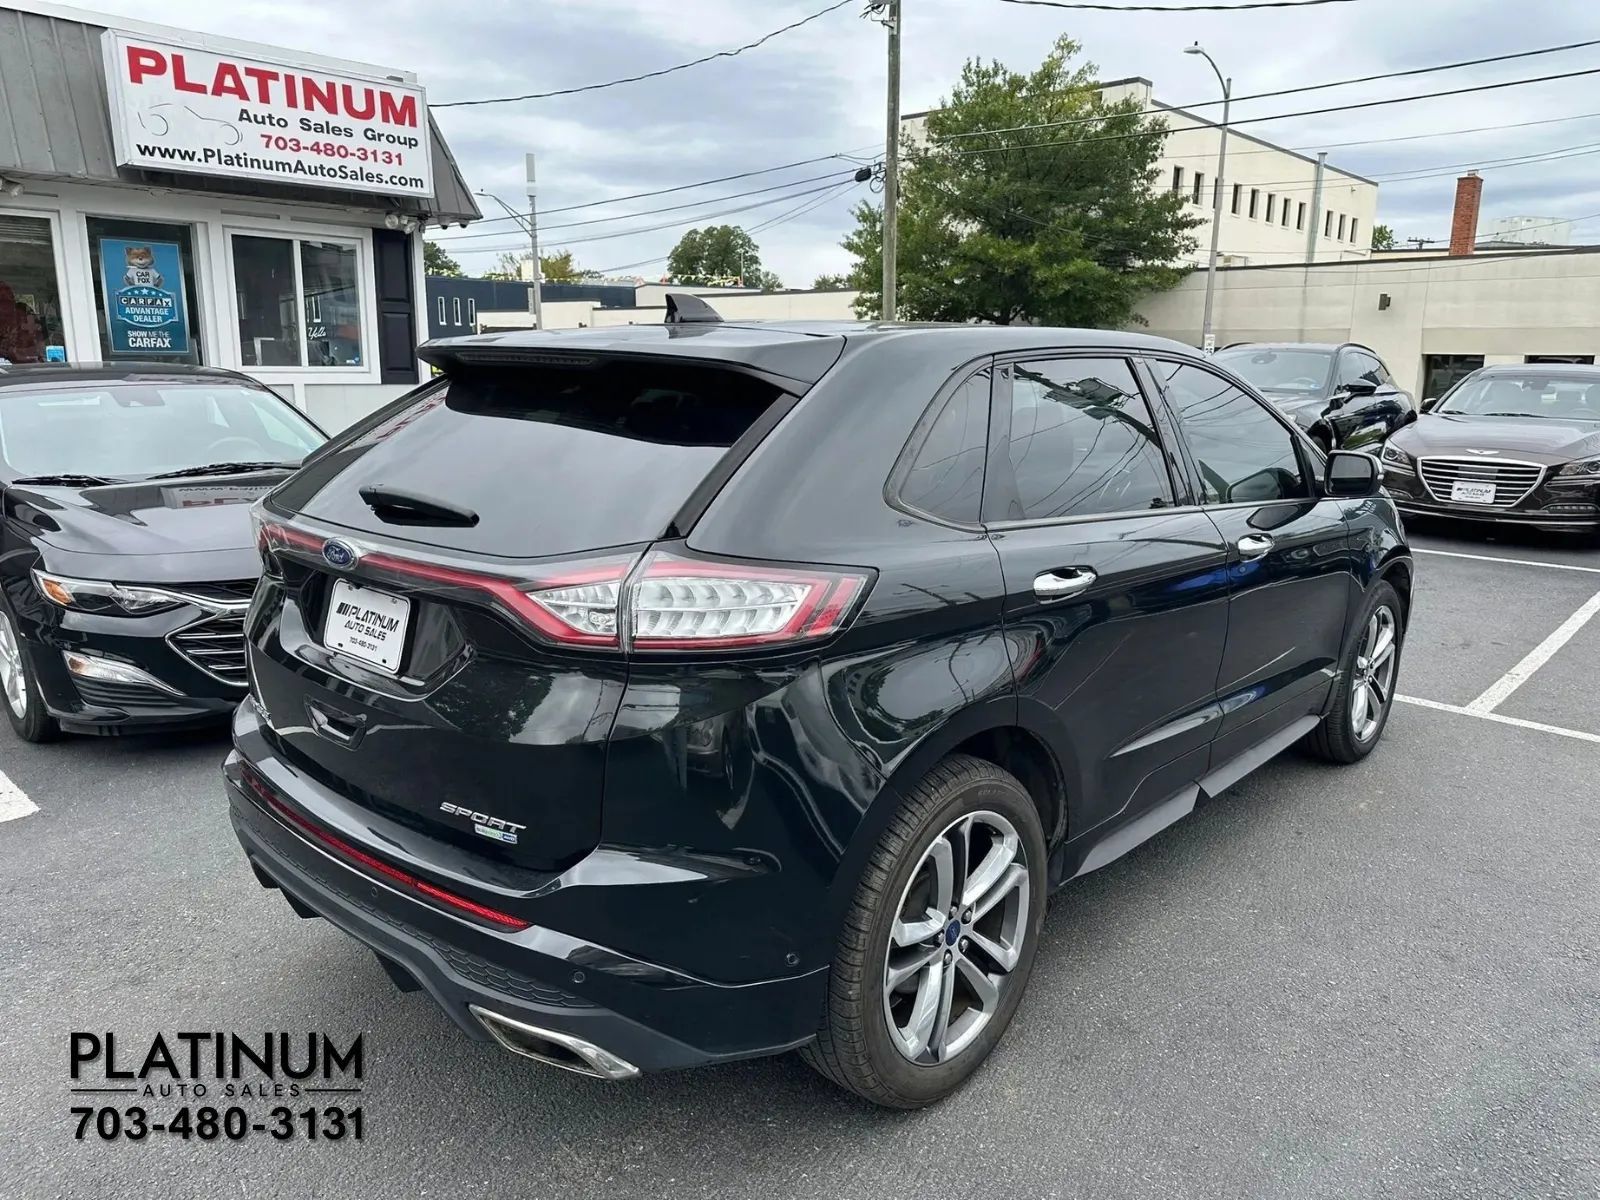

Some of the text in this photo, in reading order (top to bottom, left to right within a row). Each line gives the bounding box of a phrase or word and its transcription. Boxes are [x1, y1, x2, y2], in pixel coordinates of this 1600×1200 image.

[126, 45, 418, 128] PLATINUM
[238, 108, 419, 149] Auto Sales Group
[260, 133, 403, 166] 703-480-3131
[136, 143, 424, 189] www.PlatinumAutoSales.com
[121, 297, 172, 307] CARFAX
[125, 307, 169, 316] ADVANTAGE
[133, 314, 163, 323] DEALER
[127, 330, 147, 338] SHOW
[128, 337, 171, 348] CARFAX
[344, 619, 387, 642] AUTO SALES
[348, 606, 399, 632] PLATINUM
[440, 801, 527, 833] SPORT
